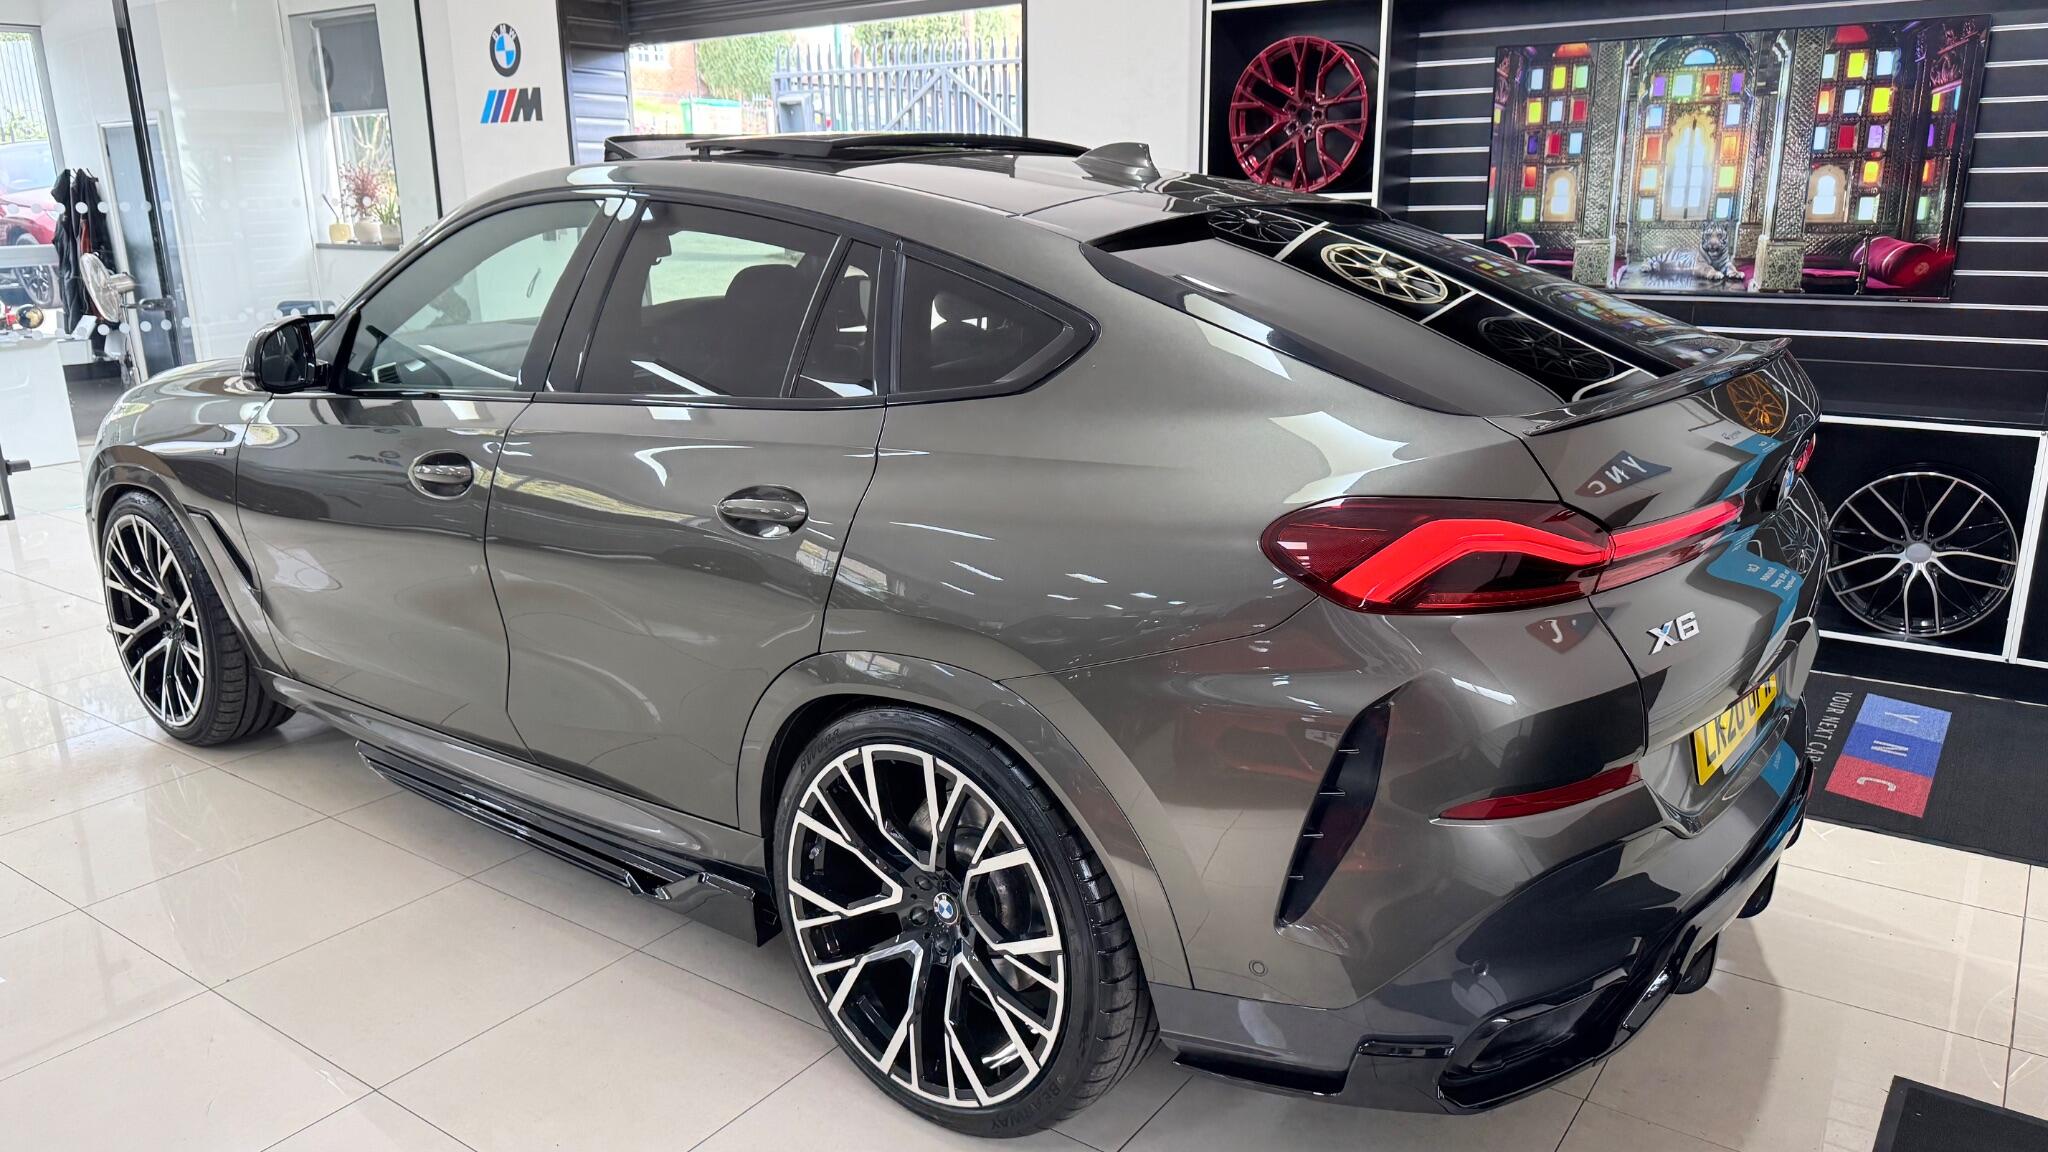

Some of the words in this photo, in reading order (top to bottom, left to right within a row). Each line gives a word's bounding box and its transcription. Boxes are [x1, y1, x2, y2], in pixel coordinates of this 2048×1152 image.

[492, 24, 517, 40] BMW
[1646, 611, 1700, 655] X6
[1826, 691, 1853, 714] YOUR
[1814, 715, 1840, 740] NEXT
